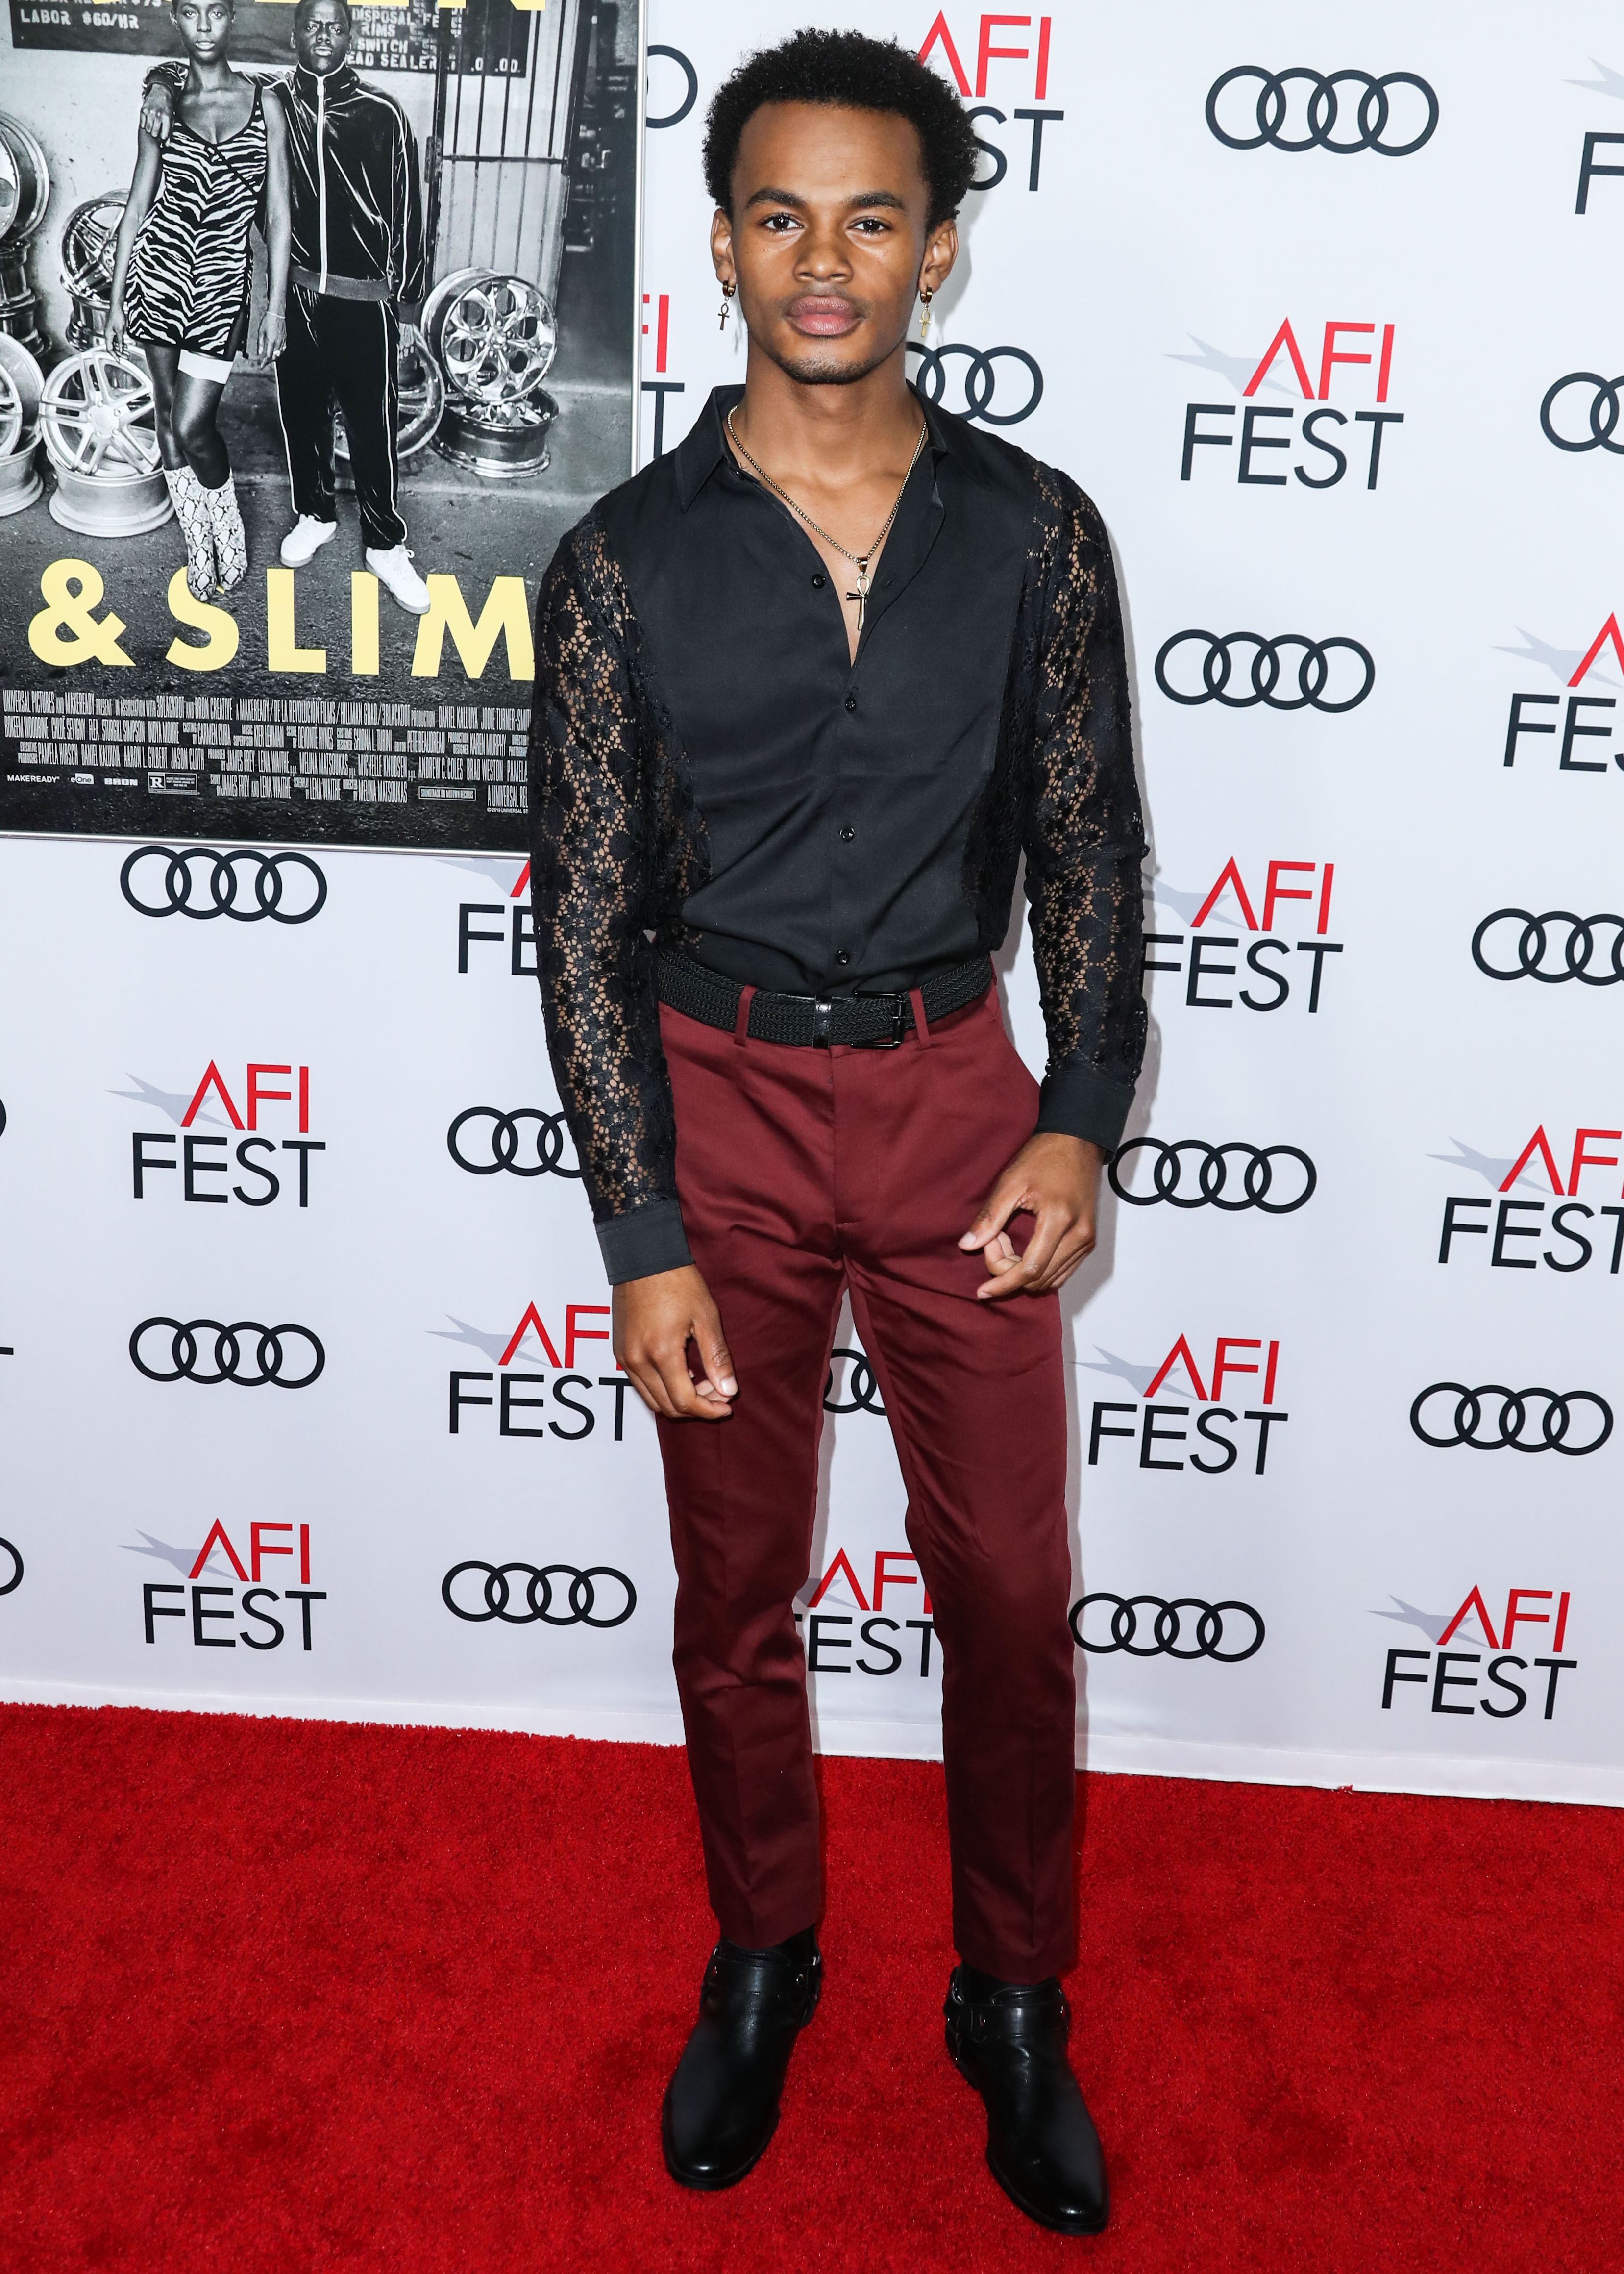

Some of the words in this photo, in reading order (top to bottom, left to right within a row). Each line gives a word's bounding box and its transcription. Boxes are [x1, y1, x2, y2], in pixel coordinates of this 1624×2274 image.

[21, 9, 71, 25] LABOR
[82, 11, 140, 29] $60/HR
[352, 7, 413, 25] DISPOSAL
[357, 38, 409, 53] SWITCH
[361, 23, 396, 37] RIMS
[380, 54, 437, 70] SEALER
[971, 106, 1064, 191] ST
[1242, 317, 1395, 402] AFI
[1181, 403, 1404, 490] FEST
[28, 558, 137, 667] &
[165, 566, 535, 681] SLIM
[3, 690, 31, 712] UNIVERSAL
[31, 691, 54, 713] PICTURES
[56, 697, 64, 714] AND
[65, 692, 95, 715] MAKEREADY
[96, 698, 112, 716] PRESENT
[115, 699, 120, 716] IN
[121, 699, 146, 717] ASSOCIATION
[146, 700, 156, 717] WITH
[156, 695, 184, 718] 3BLACKDOT
[185, 701, 194, 719] AND
[195, 697, 209, 720] BRON
[210, 697, 233, 720] CREATIVE
[236, 703, 239, 721] A
[281, 700, 288, 722] LA
[411, 710, 435, 728] PRODUCTION
[439, 705, 456, 729] DANIEL
[456, 706, 478, 729] KALUUYA
[481, 707, 495, 730] JODIE
[4, 715, 24, 738] BOKEEM
[24, 716, 49, 739] WOODBINE
[66, 717, 86, 741] SEVIGNY
[89, 718, 99, 741] FLEA
[102, 719, 123, 742] STURGILL
[123, 720, 145, 743] SIMPSON
[148, 721, 162, 744] INDYA
[162, 721, 179, 744] MOORE
[197, 723, 218, 745] CARMEN
[218, 723, 231, 746] CUBA
[254, 725, 264, 747] KIER
[265, 725, 284, 748] LEHMAN
[319, 727, 334, 750] HYNES
[354, 728, 371, 751] SHIONA
[377, 729, 392, 751] TURINI
[407, 730, 418, 752] PETE
[418, 731, 445, 754] BEAUDREAU
[470, 733, 485, 755] KAREN
[486, 734, 507, 756] MURPHY
[1503, 693, 1624, 772] FE
[7, 775, 57, 783] MAKEREADY
[38, 742, 58, 765] PAMELA
[59, 743, 78, 766] HIRSCH
[81, 743, 98, 766] DANIEL
[99, 744, 121, 767] KALUUYA
[124, 745, 142, 768] AARON
[142, 746, 147, 768] L.
[148, 746, 168, 769] GILBERT
[171, 747, 188, 770] JASON
[189, 748, 204, 770] CLOTH
[226, 749, 243, 772] JAMES
[244, 750, 255, 772] FREY
[258, 750, 271, 773] LENA
[299, 752, 318, 775] MELINA
[319, 752, 348, 775] MATSOUKAS
[358, 754, 382, 776] MICHELLE
[383, 755, 407, 777] KNUDSEN
[418, 756, 441, 779] ANDREW
[442, 757, 447, 780] C.
[447, 757, 463, 780] COLES
[467, 758, 481, 781] BRAD
[481, 759, 503, 782] WESTON
[149, 777, 164, 789] R
[221, 774, 238, 797] JAMES
[239, 775, 250, 797] FREY
[251, 780, 259, 798] AND
[259, 775, 272, 798] LENA
[272, 776, 291, 799] WAITHE
[309, 778, 322, 800] LENA
[322, 778, 342, 800] WAITHE
[358, 780, 377, 802] MELINA
[377, 780, 408, 803] MATSOUKAS
[488, 784, 491, 807] A
[492, 785, 518, 808] UNIVERSAL
[1190, 856, 1334, 934] AFI
[459, 903, 537, 976] FE
[180, 1059, 309, 1133] AFI
[132, 1132, 326, 1207] FEST
[1498, 1124, 1624, 1199] AF
[498, 1301, 625, 1369] AF
[1143, 1333, 1279, 1404] AFI
[449, 1371, 632, 1441] FEST
[1088, 1402, 1288, 1475] FEST
[188, 1518, 310, 1584] AFI
[143, 1583, 327, 1651] FEST
[795, 1613, 935, 1677] EST
[1436, 1584, 1571, 1652] AFI
[1381, 1649, 1577, 1720] FEST
